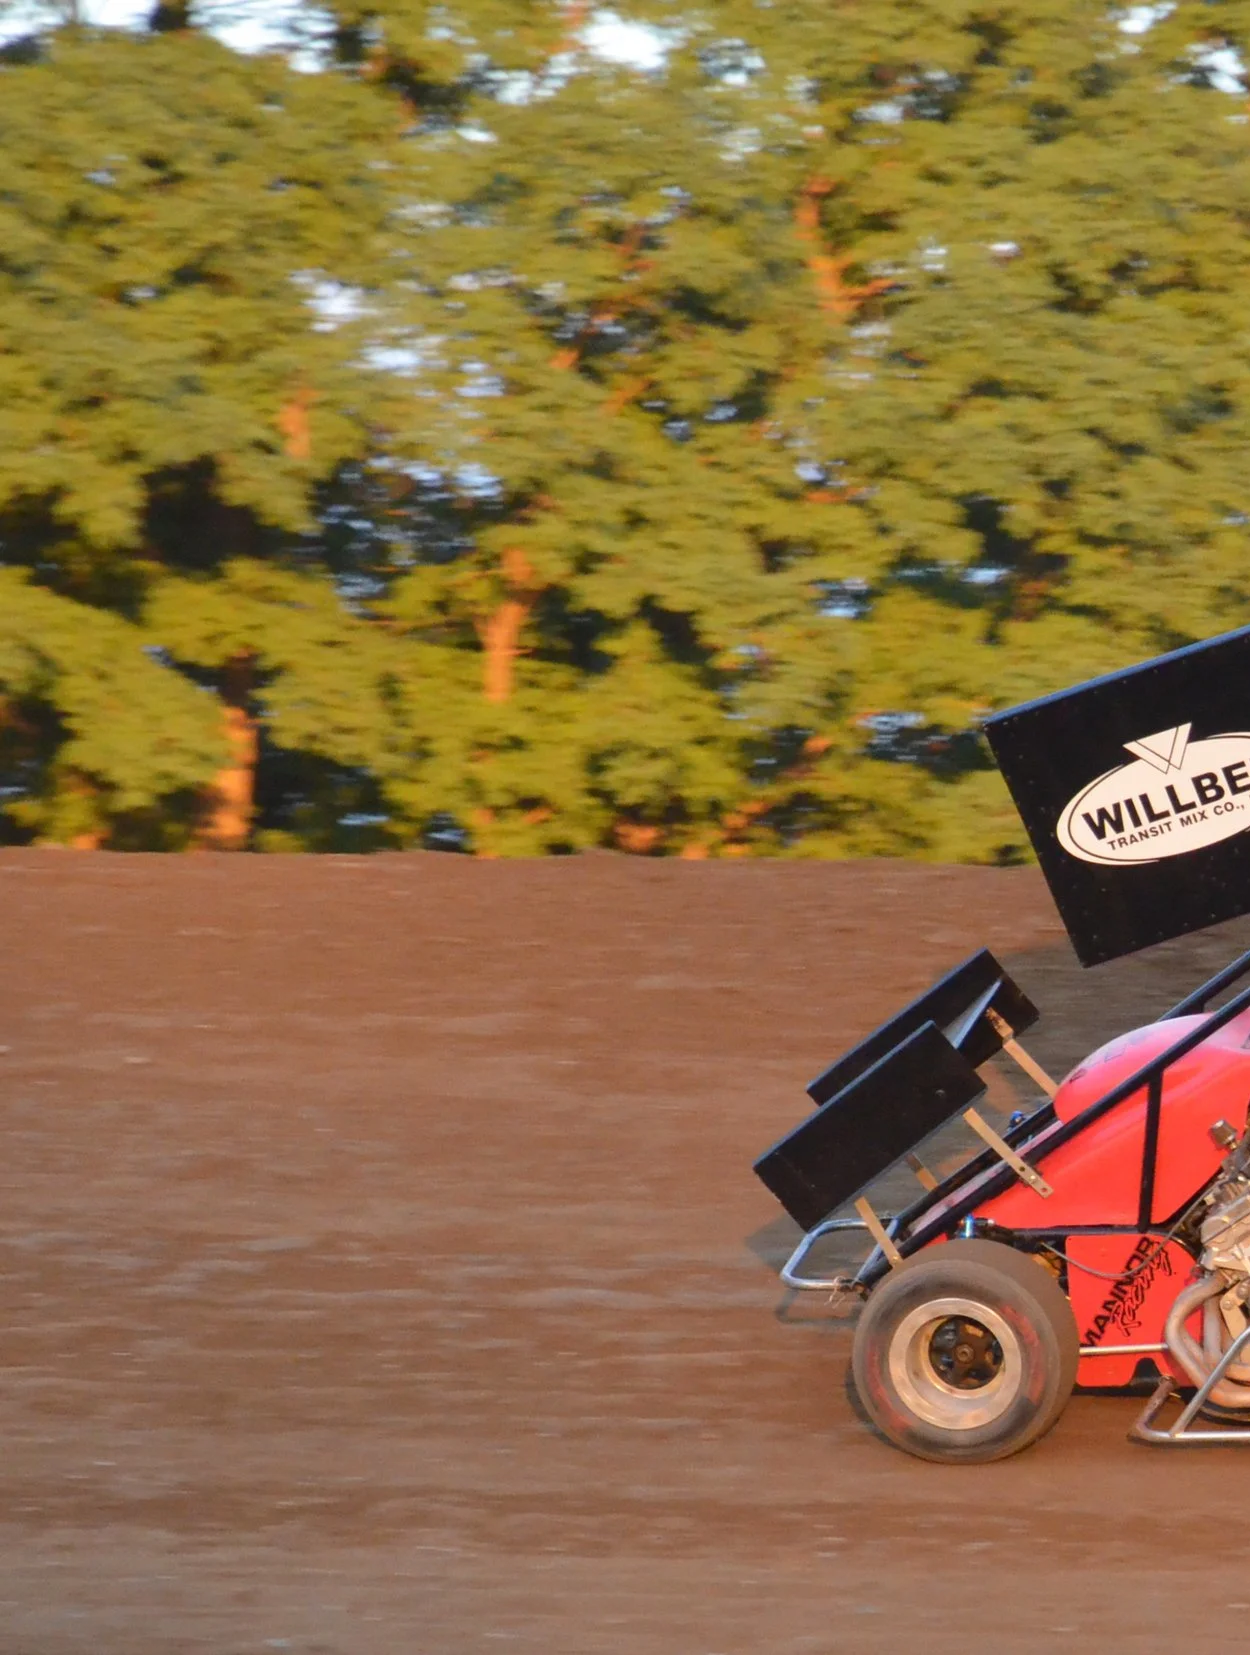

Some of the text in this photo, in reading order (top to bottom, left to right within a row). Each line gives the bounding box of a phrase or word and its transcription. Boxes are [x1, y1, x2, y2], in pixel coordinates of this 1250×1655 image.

[1107, 821, 1173, 851] TRANSIT
[1180, 810, 1209, 828] MIX
[1109, 1240, 1172, 1337] Racing
